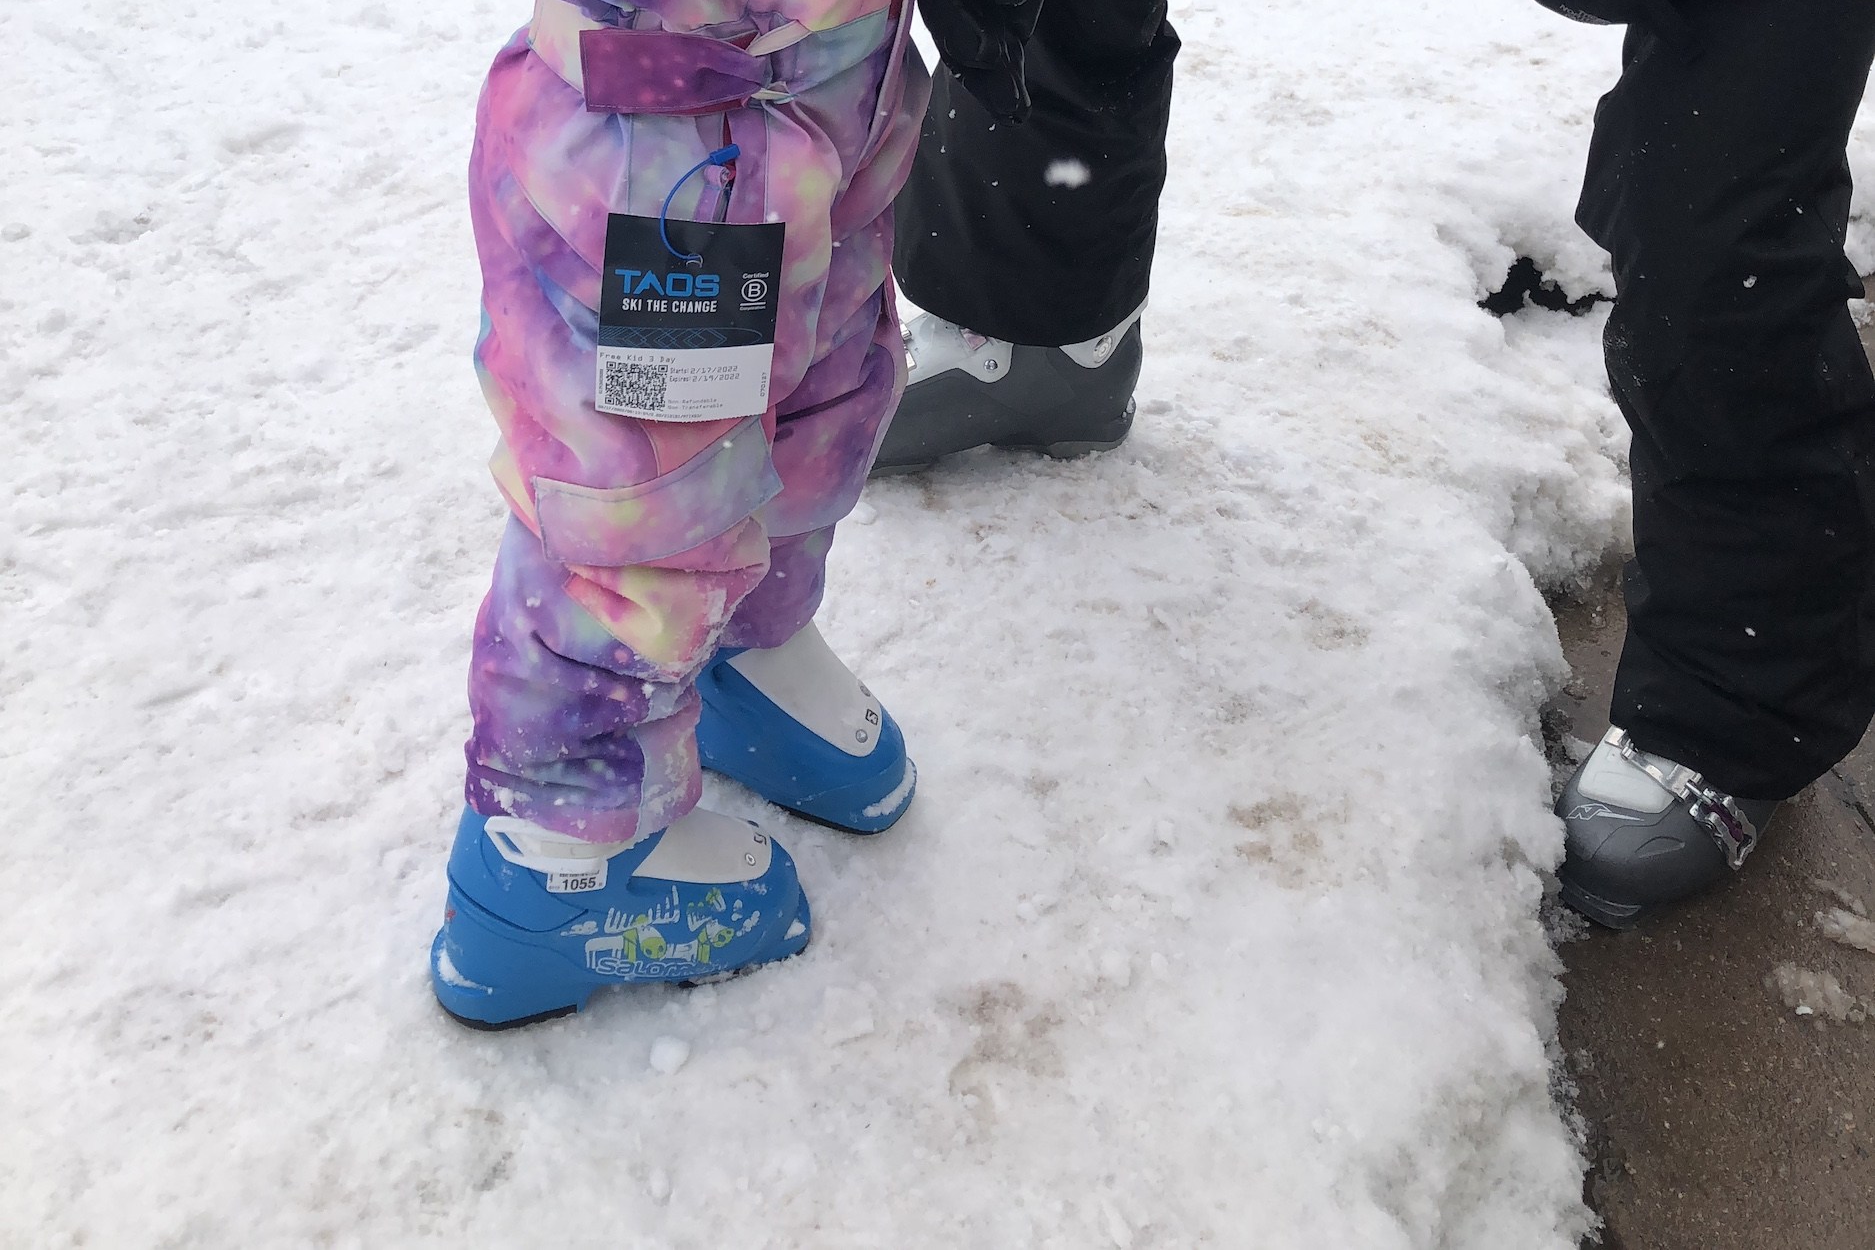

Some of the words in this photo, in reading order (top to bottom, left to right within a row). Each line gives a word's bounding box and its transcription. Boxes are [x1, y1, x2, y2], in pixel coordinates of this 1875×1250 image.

[614, 268, 721, 298] TAOS
[621, 297, 643, 312] SKI
[646, 298, 668, 313] THE
[671, 299, 718, 314] CHANGE
[600, 351, 622, 361] Free
[626, 354, 643, 362] Kid
[660, 355, 676, 365] Day
[562, 876, 597, 891] 1055
